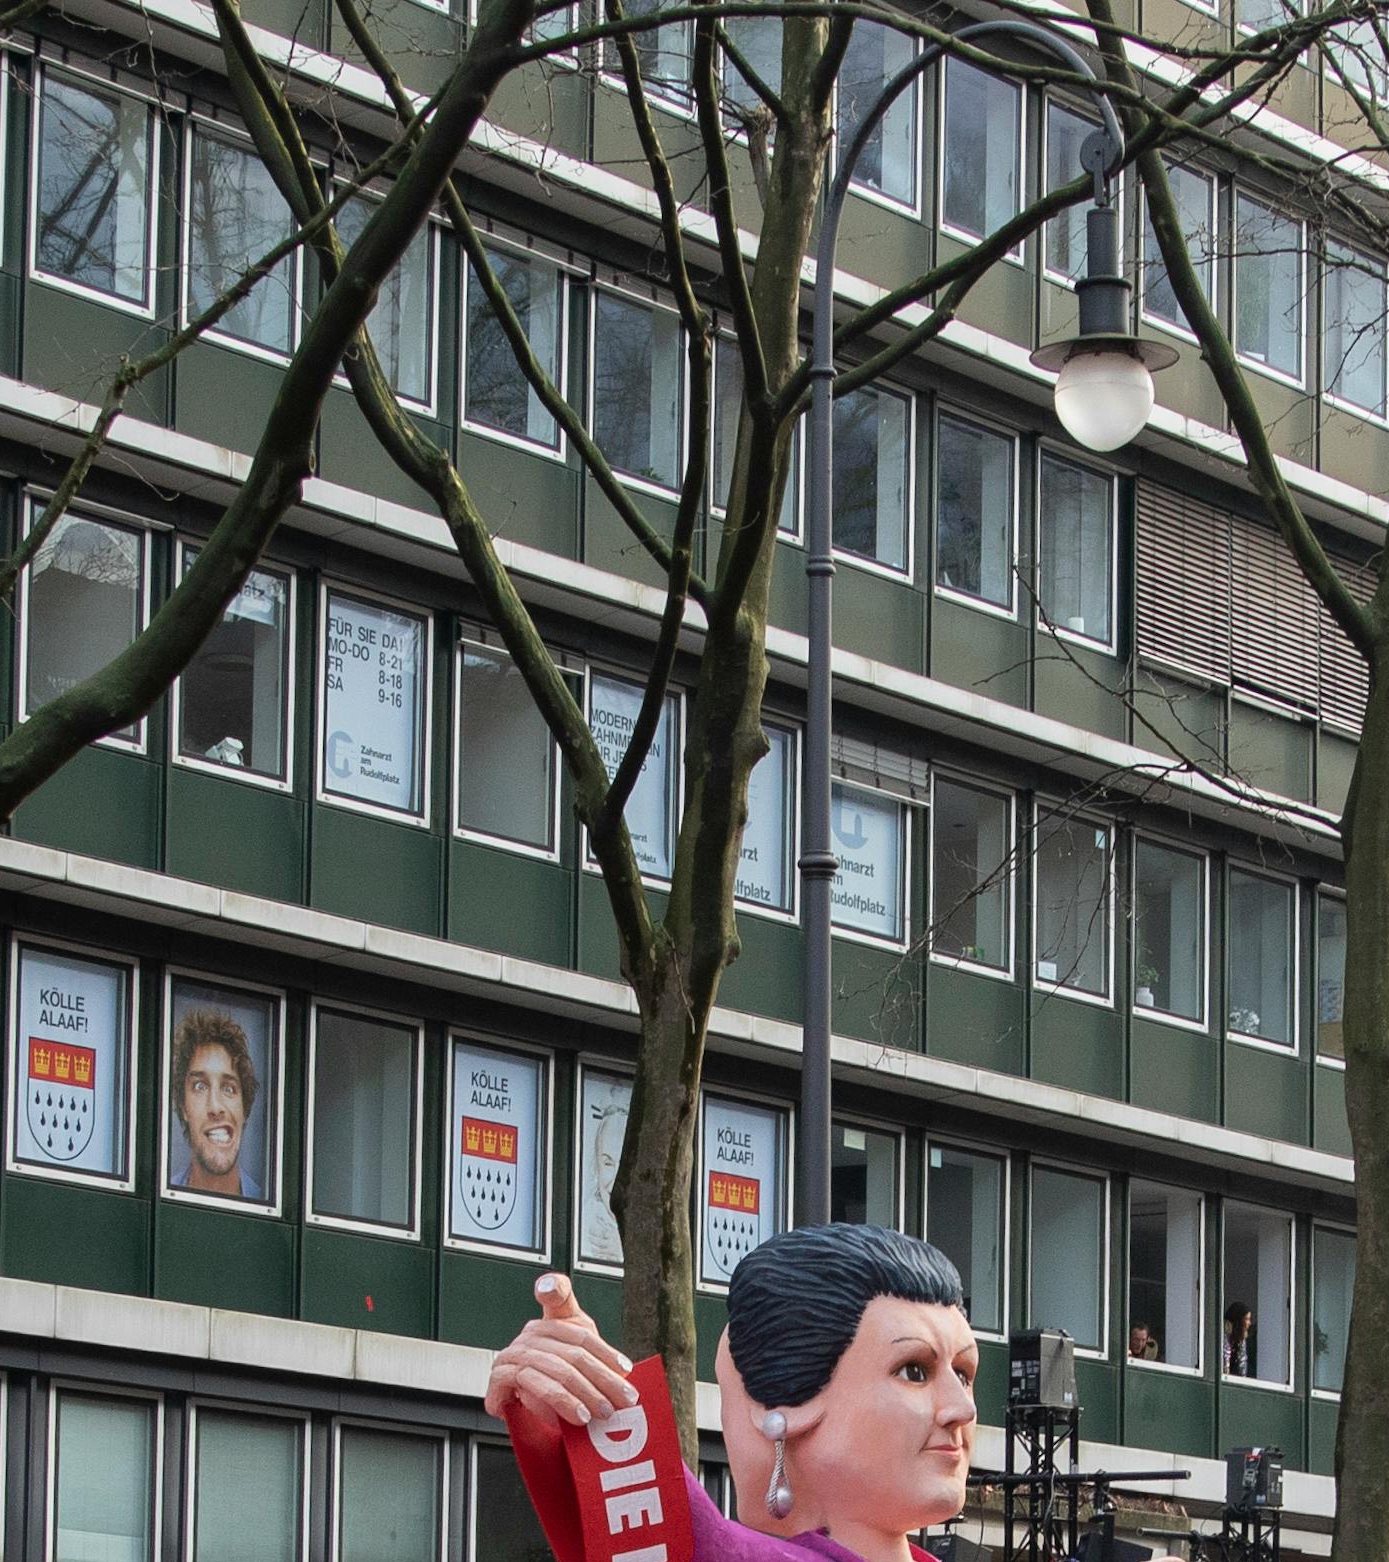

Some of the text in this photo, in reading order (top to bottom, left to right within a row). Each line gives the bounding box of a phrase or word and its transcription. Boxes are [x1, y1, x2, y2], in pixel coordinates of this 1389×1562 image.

[329, 616, 403, 652] FÜR SIE DA!
[328, 636, 403, 671] MO-DO 8-21
[328, 655, 403, 690] FR 8-18
[327, 673, 403, 708] SA 9-16
[591, 708, 637, 732] MODERN
[832, 853, 875, 878] hnarzt
[39, 986, 85, 1012] KÖLLE
[38, 1009, 88, 1033] ALAAF!
[471, 1069, 508, 1093] KÖLLE
[470, 1089, 511, 1112] ALAAF!
[717, 1127, 751, 1148] KÖLLE
[716, 1146, 755, 1166] ALAAF!
[586, 1403, 664, 1536] DIE
